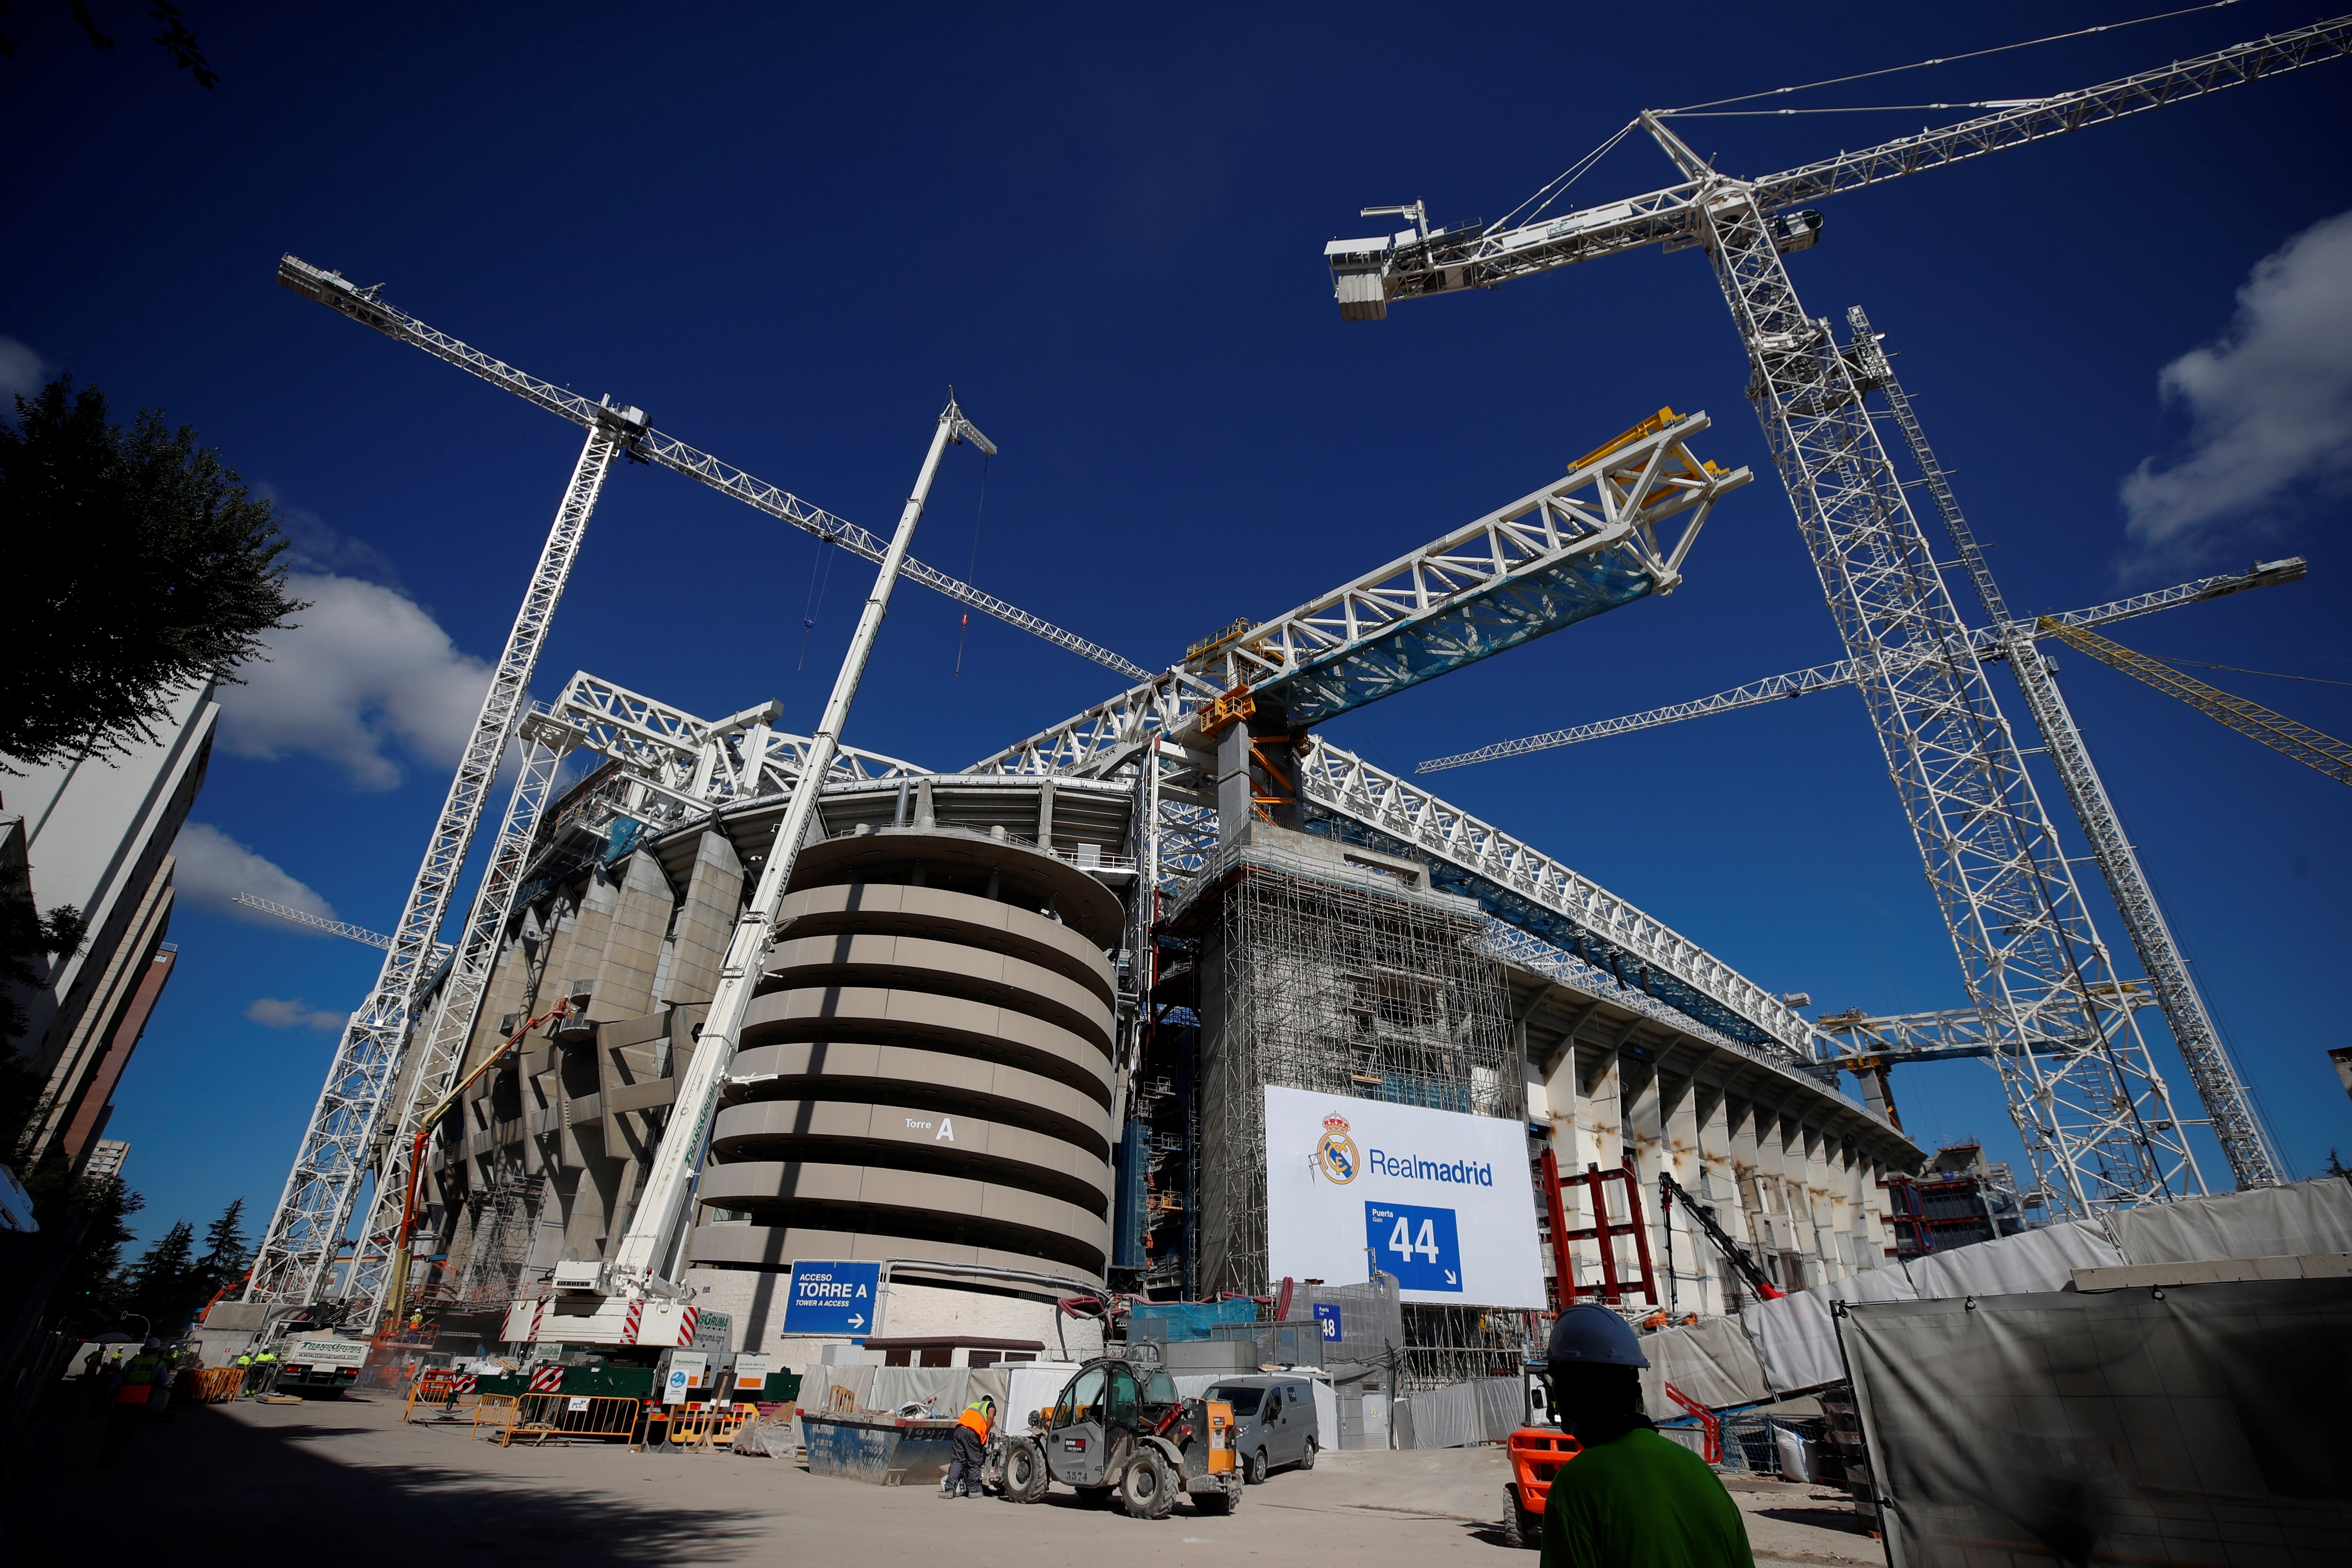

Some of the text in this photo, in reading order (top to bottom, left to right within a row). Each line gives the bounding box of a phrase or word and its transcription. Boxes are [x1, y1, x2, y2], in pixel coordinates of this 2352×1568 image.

[777, 758, 829, 898] www.transgruma.com
[905, 1118, 954, 1142] Torre A
[1369, 1148, 1493, 1187] Realmadrid
[1372, 1208, 1393, 1218] Puerta
[1389, 1216, 1439, 1264] 44
[799, 1273, 832, 1281] ACCESO
[798, 1283, 867, 1298] TORRE A
[1323, 1318, 1335, 1337] 48
[1066, 1471, 1088, 1482] 3574
